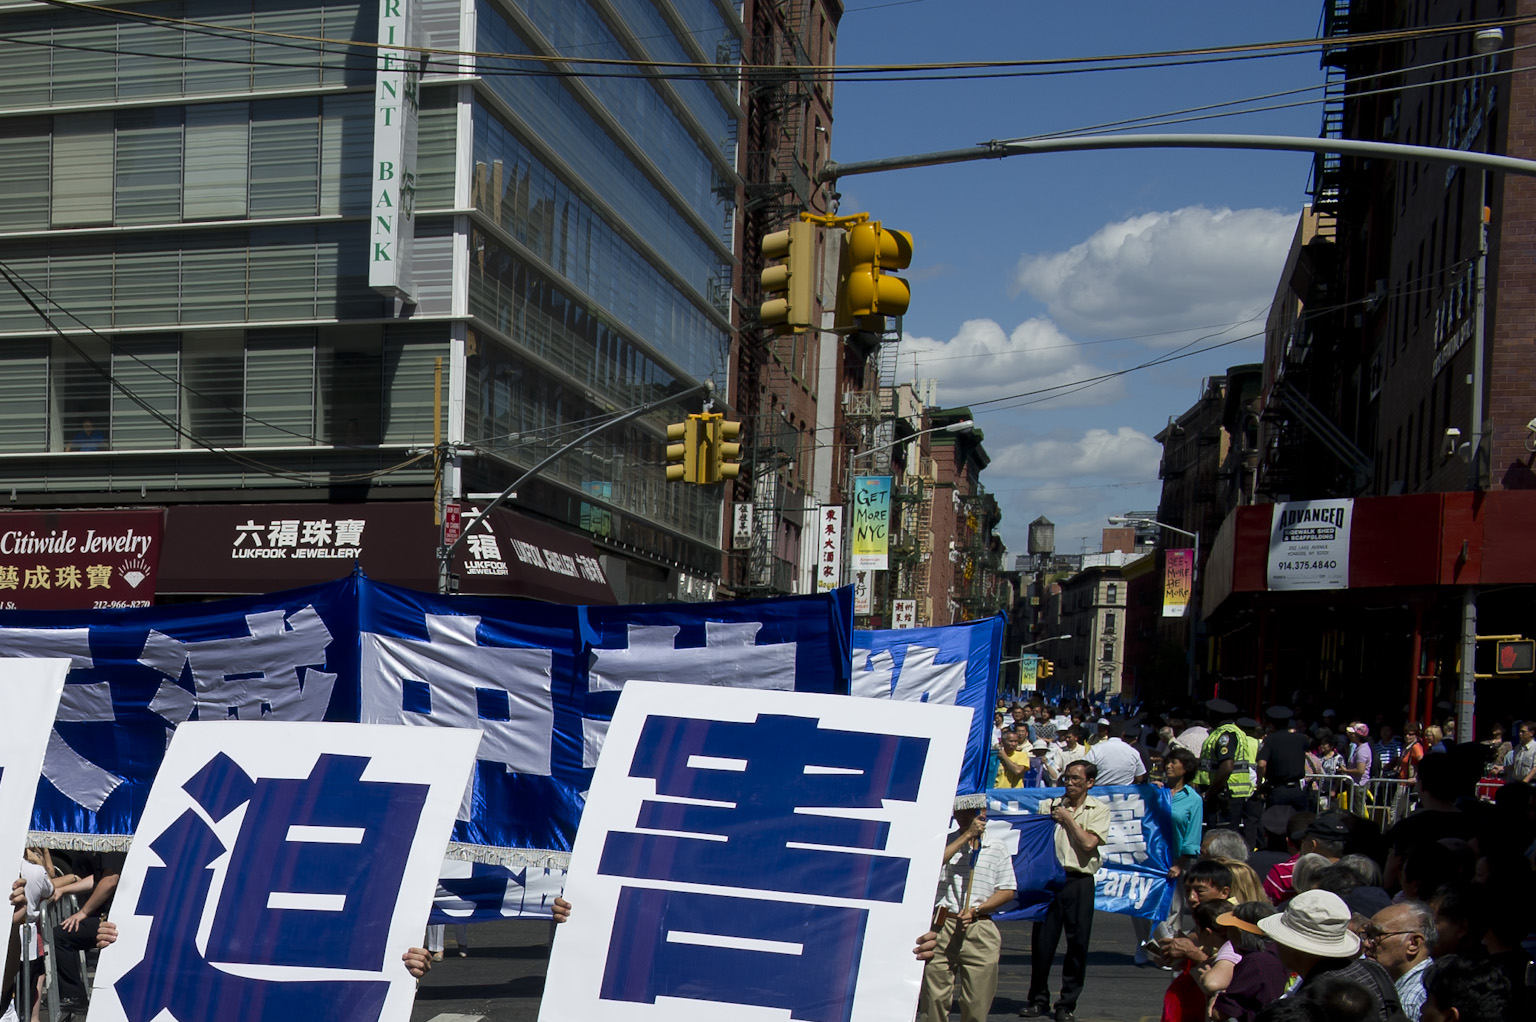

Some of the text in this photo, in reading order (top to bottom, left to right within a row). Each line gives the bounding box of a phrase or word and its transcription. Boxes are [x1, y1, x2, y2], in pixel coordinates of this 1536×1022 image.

[374, 161, 395, 262] BANK
[857, 488, 889, 507] GET
[856, 508, 888, 522] MORE
[1279, 507, 1345, 531] ADVANCED
[232, 518, 366, 548] 六福珠寶
[857, 524, 886, 542] NYC
[0, 529, 77, 555] Citiwide
[80, 528, 153, 559] Jewelry
[231, 547, 363, 559] LUKFOOK JEWELLERY
[464, 560, 508, 570] LUKFOOK
[1278, 560, 1337, 571] 914.375.4840
[1093, 866, 1154, 910] Party
